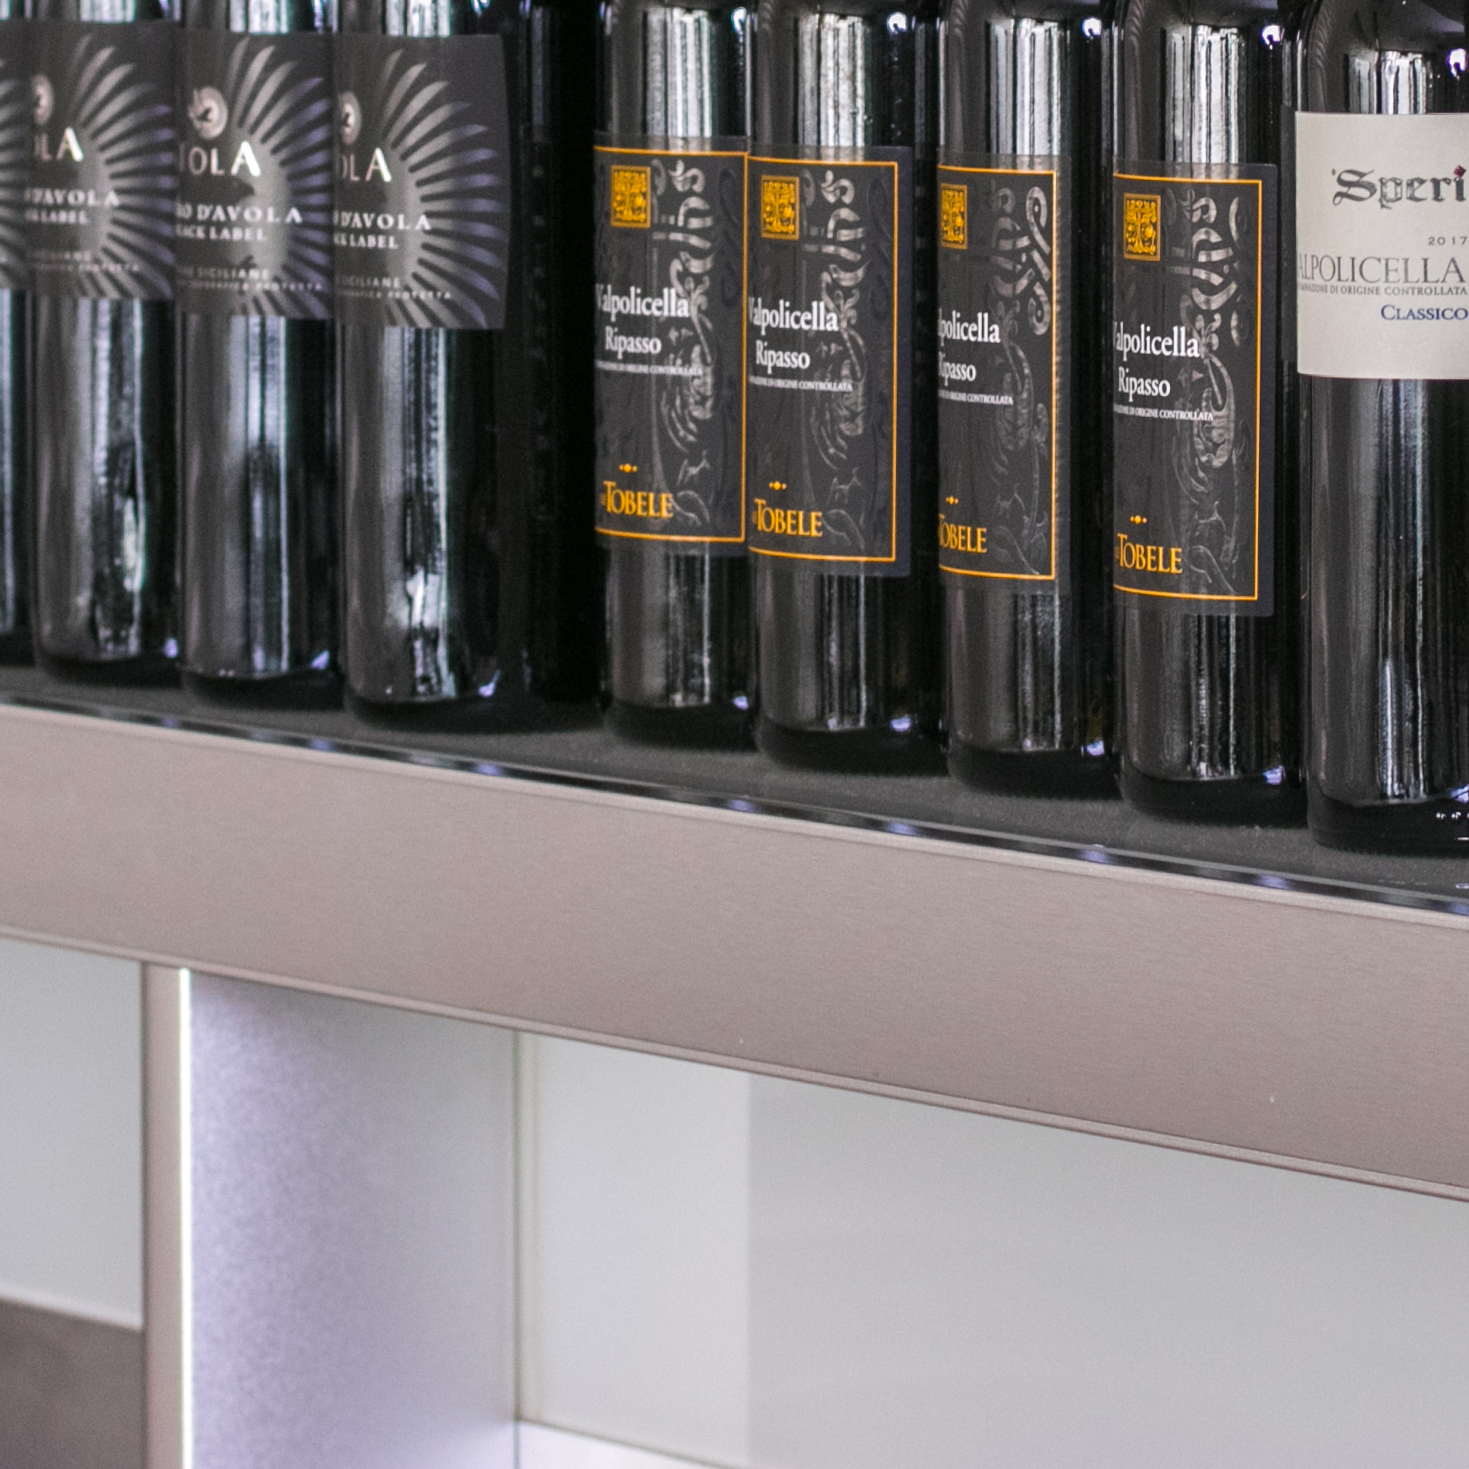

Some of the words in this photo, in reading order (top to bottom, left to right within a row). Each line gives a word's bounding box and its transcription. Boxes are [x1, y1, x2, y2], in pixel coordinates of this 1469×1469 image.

[1332, 165, 1467, 210] Speri
[196, 204, 304, 224] D'AVOLA
[340, 211, 432, 232] D'AVOLA
[208, 226, 266, 242] LABEL
[349, 234, 399, 250] LABEL
[1428, 235, 1468, 246] 2017
[1297, 253, 1467, 284] ALPOLICELLA
[1331, 284, 1339, 295] DI
[1340, 285, 1381, 296] ORIGINE
[1384, 286, 1468, 297] CONTROLLATA
[1381, 304, 1469, 321] CLASSICO
[605, 326, 662, 360] Ripasso
[756, 339, 811, 375] Ripasso
[799, 380, 853, 392] CONTROLLATA
[1118, 366, 1171, 403] Ripasso
[967, 393, 1014, 406] CONTROLLATA
[1159, 409, 1214, 422] CONTROLLATA
[603, 480, 674, 518] TOBELE
[754, 498, 824, 538] TOBELE
[1117, 533, 1183, 575] TOBELE
